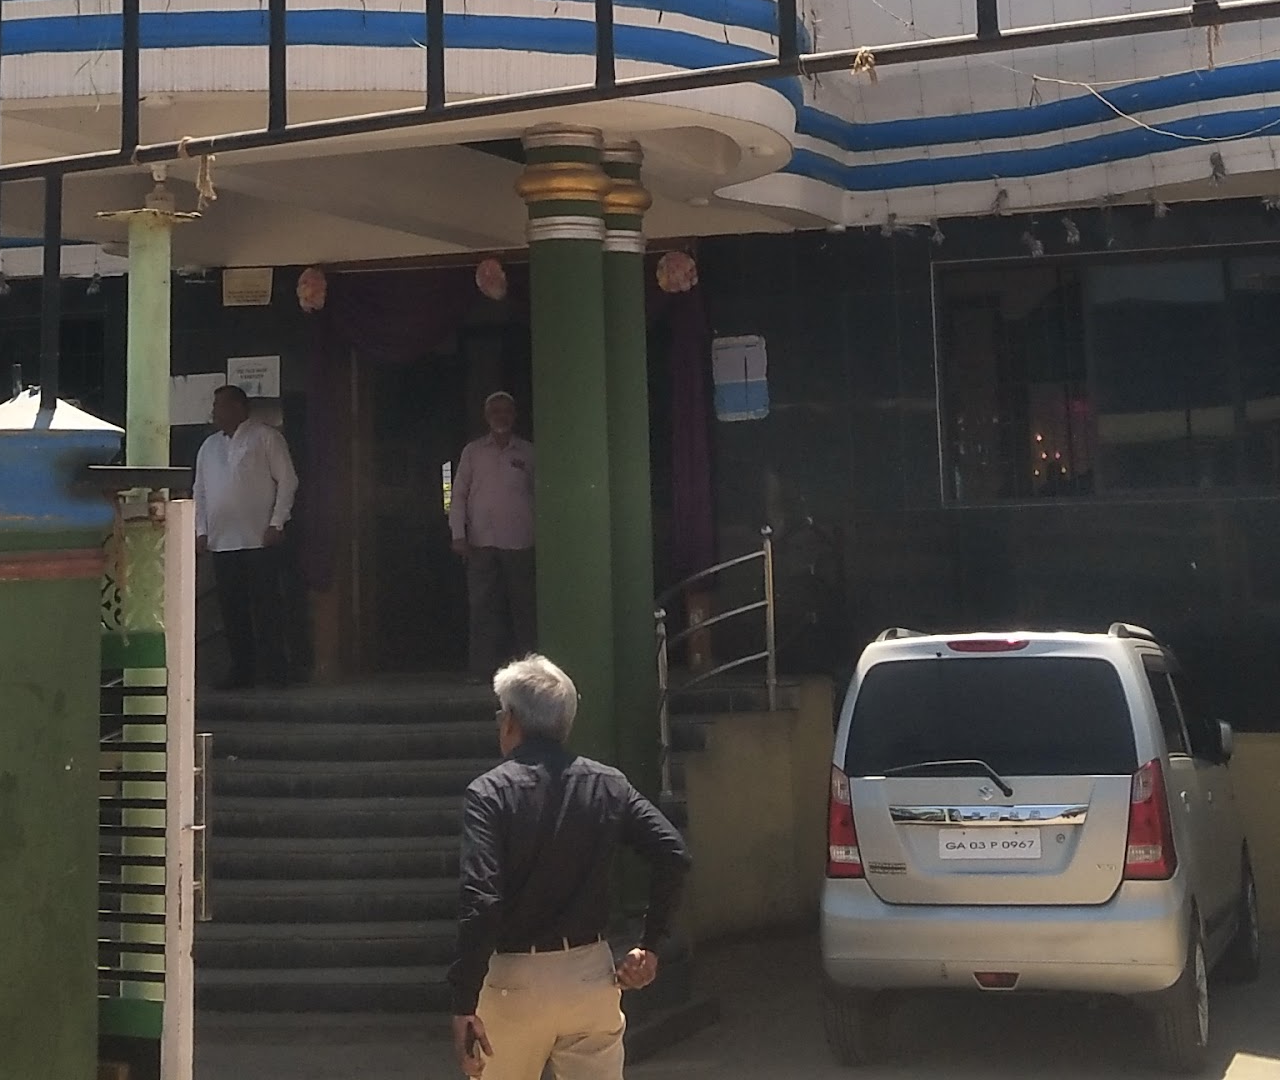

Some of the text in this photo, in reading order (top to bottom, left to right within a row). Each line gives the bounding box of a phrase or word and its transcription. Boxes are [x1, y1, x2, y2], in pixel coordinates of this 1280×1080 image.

[945, 838, 1035, 851] GA 03 P 0967
